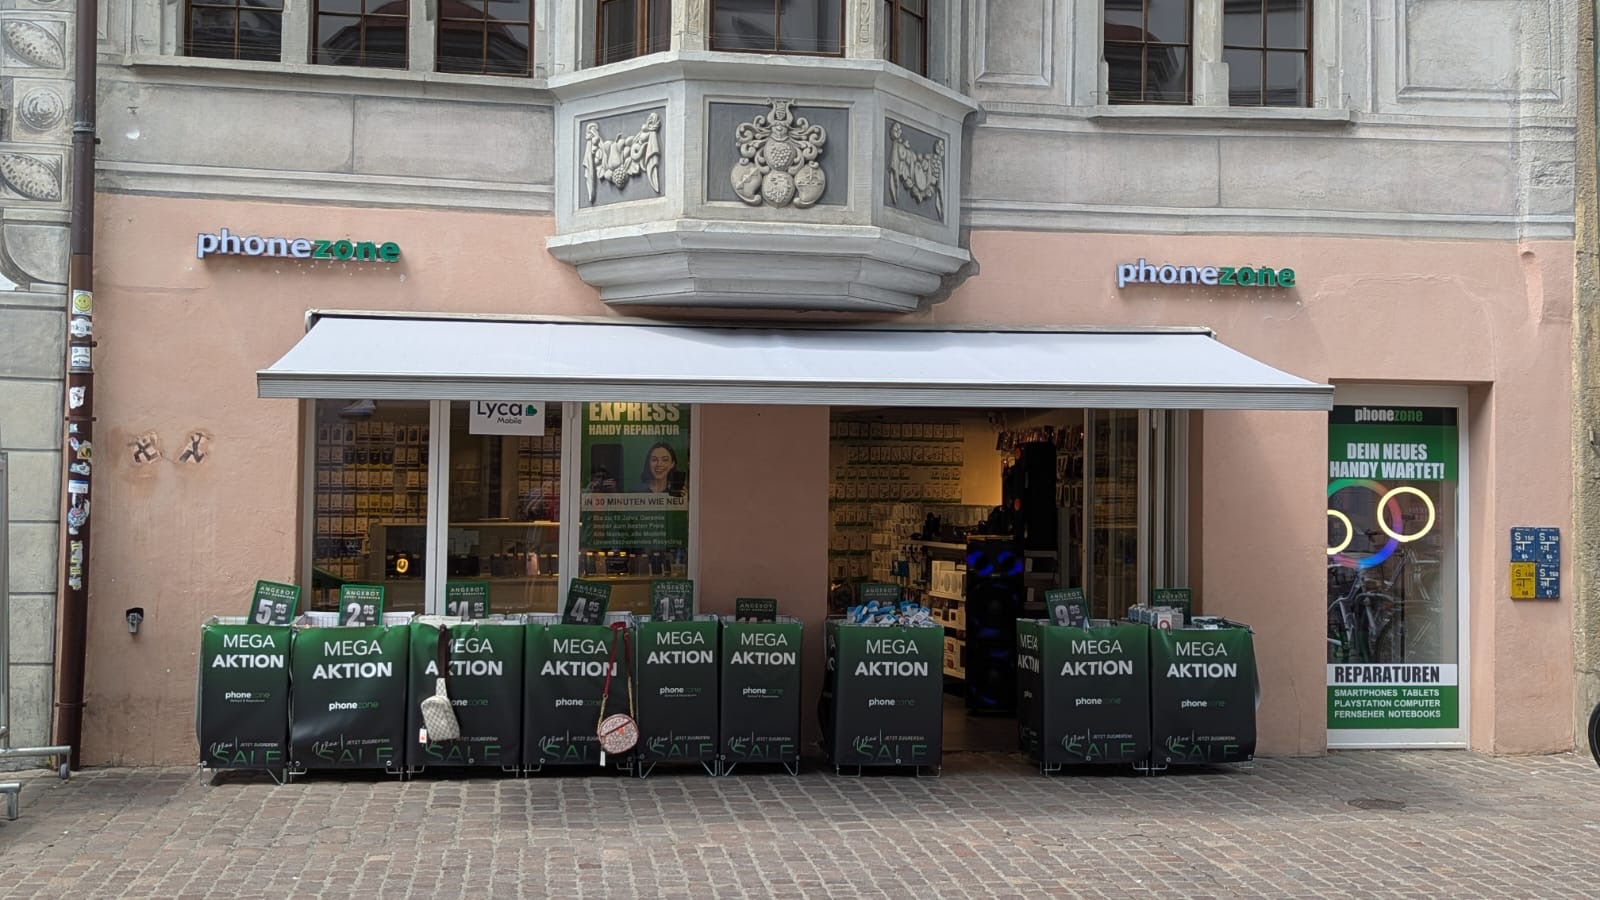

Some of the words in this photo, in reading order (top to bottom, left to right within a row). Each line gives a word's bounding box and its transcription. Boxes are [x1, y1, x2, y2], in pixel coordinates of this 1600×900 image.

[197, 228, 401, 263] phonezone
[1117, 258, 1296, 288] phonezone
[477, 401, 523, 418] Lyca
[590, 402, 680, 421] EXPRESS
[1354, 407, 1423, 423] phonezone
[497, 417, 523, 425] Mobile
[589, 424, 622, 436] HANDY
[624, 424, 680, 436] REPARATUR
[1347, 443, 1380, 460] DEIN
[1383, 443, 1428, 461] NEUES
[1330, 461, 1379, 478] HANDY
[1381, 462, 1445, 479] WARTET!
[584, 498, 593, 506] IN
[594, 498, 605, 506] 30
[607, 498, 646, 506] MINUTEN
[648, 498, 665, 506] WIE
[666, 498, 685, 506] NEU
[1515, 532, 1522, 541] S
[1539, 533, 1546, 541] S
[1539, 569, 1546, 577] S
[259, 586, 295, 596] ANGEBOT
[223, 634, 275, 648] MEGA
[656, 632, 705, 646] MEGA
[741, 633, 788, 647] MEGA
[324, 640, 383, 657] MEGA
[553, 639, 608, 655] MEGA
[866, 640, 919, 654] MEGA
[1071, 640, 1123, 656] MEGA
[1176, 642, 1228, 657] MEGA
[212, 654, 285, 668] AKTION
[646, 651, 713, 665] AKTION
[730, 652, 797, 666] AKTION
[312, 662, 393, 680] AKTION
[541, 662, 618, 677] AKTION
[854, 662, 928, 676] AKTION
[1061, 661, 1133, 676] AKTION
[1166, 663, 1237, 678] AKTION
[1334, 666, 1440, 683] REPARATUREN
[1334, 689, 1398, 697] SMARTPHONES
[1402, 689, 1440, 697] TABLETS
[329, 700, 379, 711] phonezone
[1334, 699, 1391, 708] PLAYSTATION
[1394, 699, 1441, 708] COMPUTER
[1334, 710, 1385, 718] FERNSEHER
[1388, 710, 1441, 718] NOTEBOOKS
